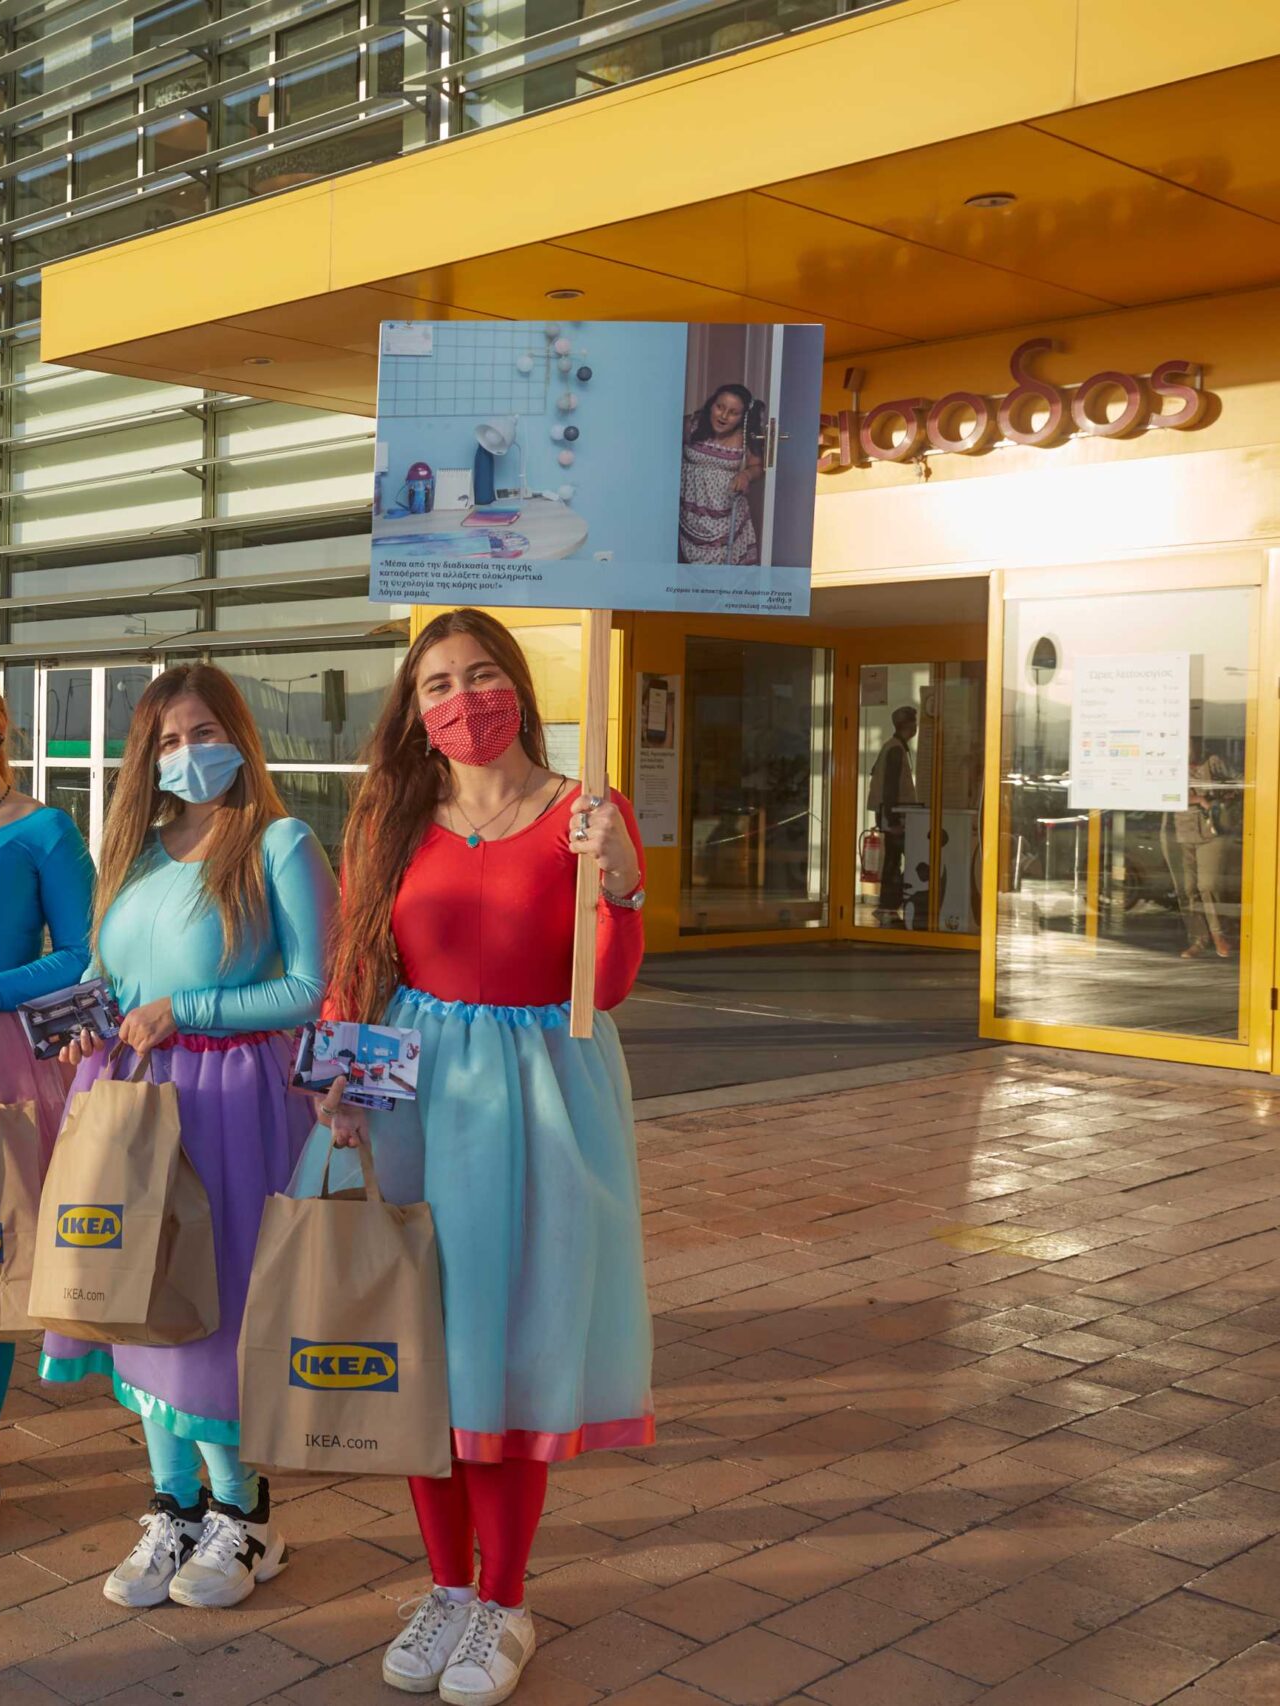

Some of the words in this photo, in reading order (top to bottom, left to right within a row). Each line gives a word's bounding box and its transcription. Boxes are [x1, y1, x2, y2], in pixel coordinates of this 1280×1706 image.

[426, 562, 442, 570] την
[442, 561, 489, 570] διαδικασία
[507, 564, 532, 572] ευχής
[379, 571, 429, 580] καταφέρατε
[442, 571, 480, 580] αλλάξετε
[379, 580, 389, 588] τη
[391, 580, 434, 589] ψυχολογία
[436, 582, 450, 590] της
[452, 582, 477, 590] κόρης
[378, 589, 402, 597] Λόγια
[404, 589, 430, 598] μαμάς
[61, 1216, 116, 1235] IKEA
[63, 1287, 105, 1302] IKEA.com
[300, 1353, 389, 1377] IKEA
[304, 1433, 379, 1450] IKEA.com
